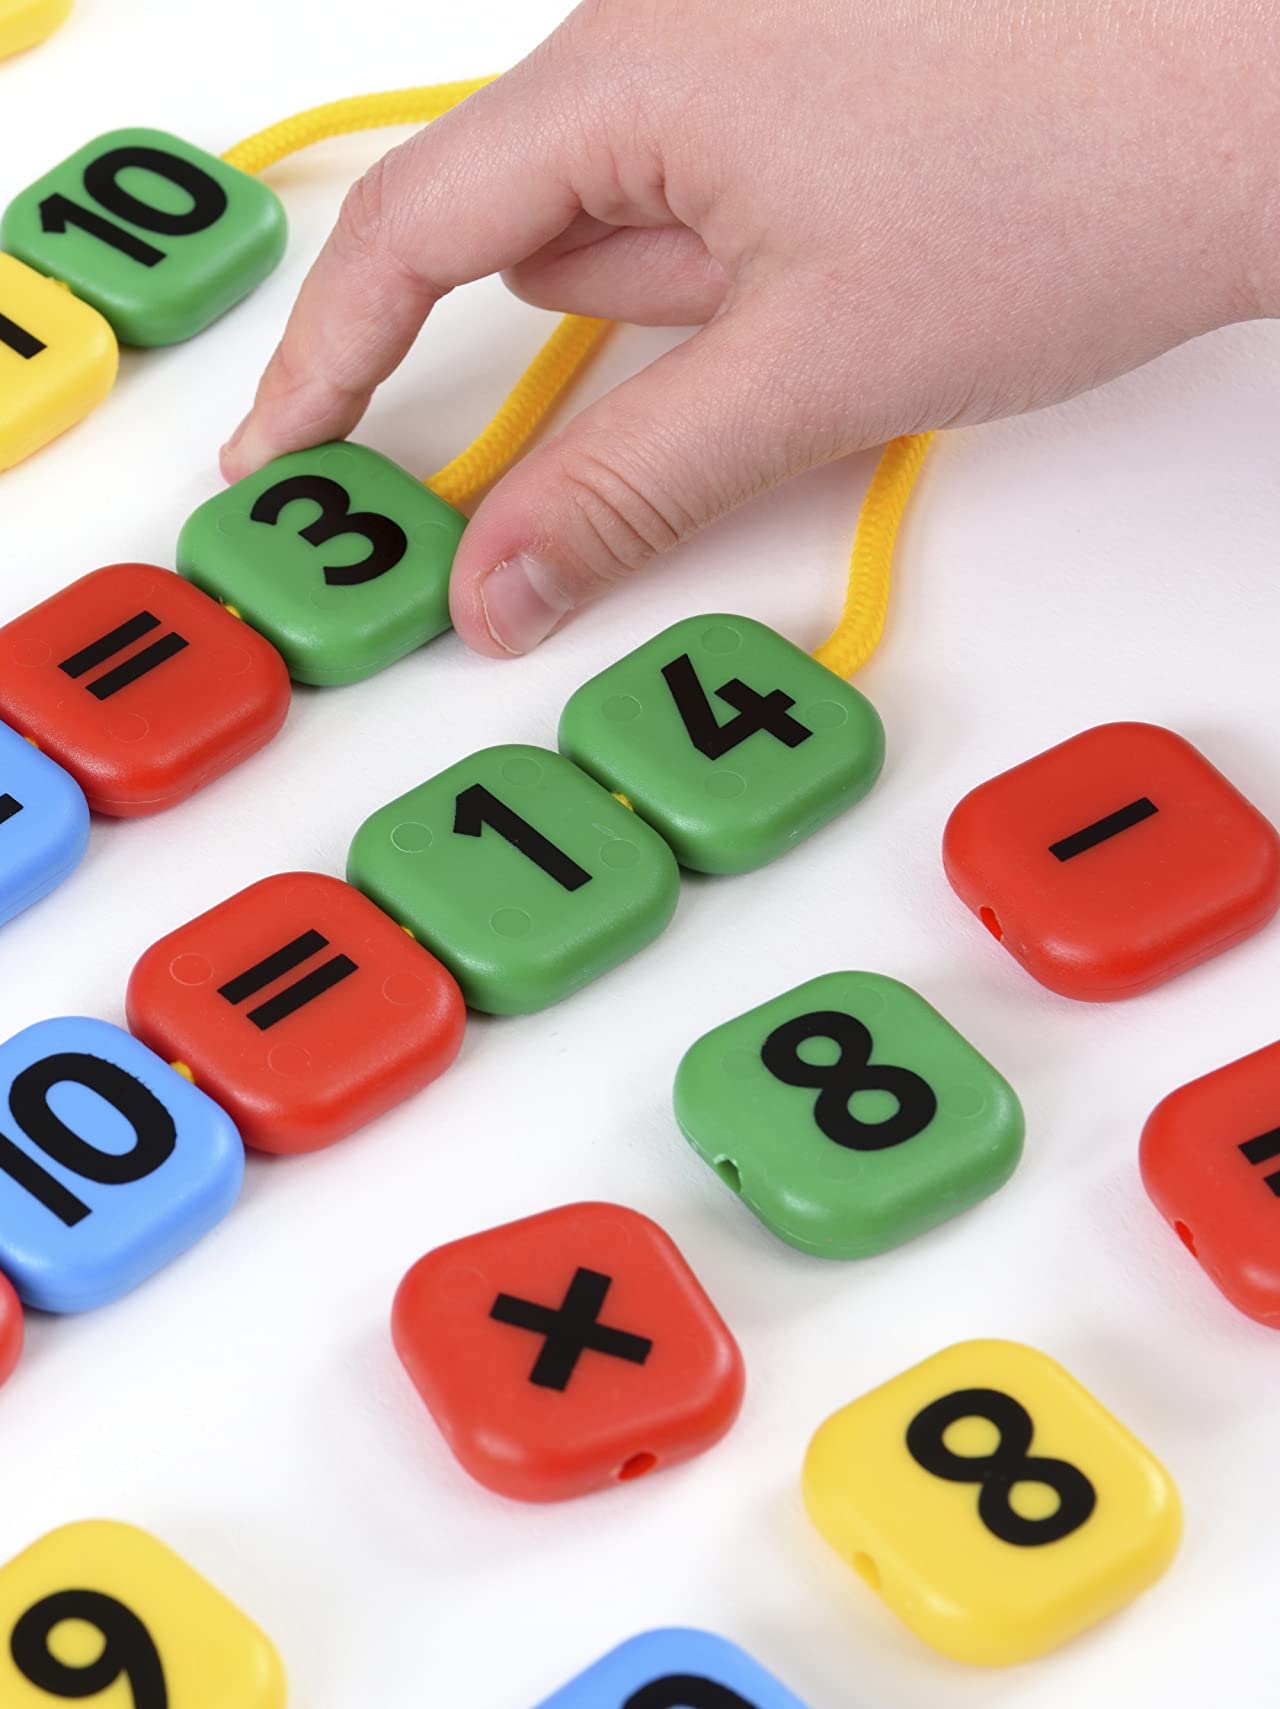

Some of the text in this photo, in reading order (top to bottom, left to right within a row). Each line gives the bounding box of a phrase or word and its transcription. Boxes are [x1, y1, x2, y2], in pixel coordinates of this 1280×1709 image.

[38, 146, 228, 268] 10
[249, 474, 409, 587] 3
[759, 1010, 938, 1152] 8
[905, 1388, 1096, 1547] 8
